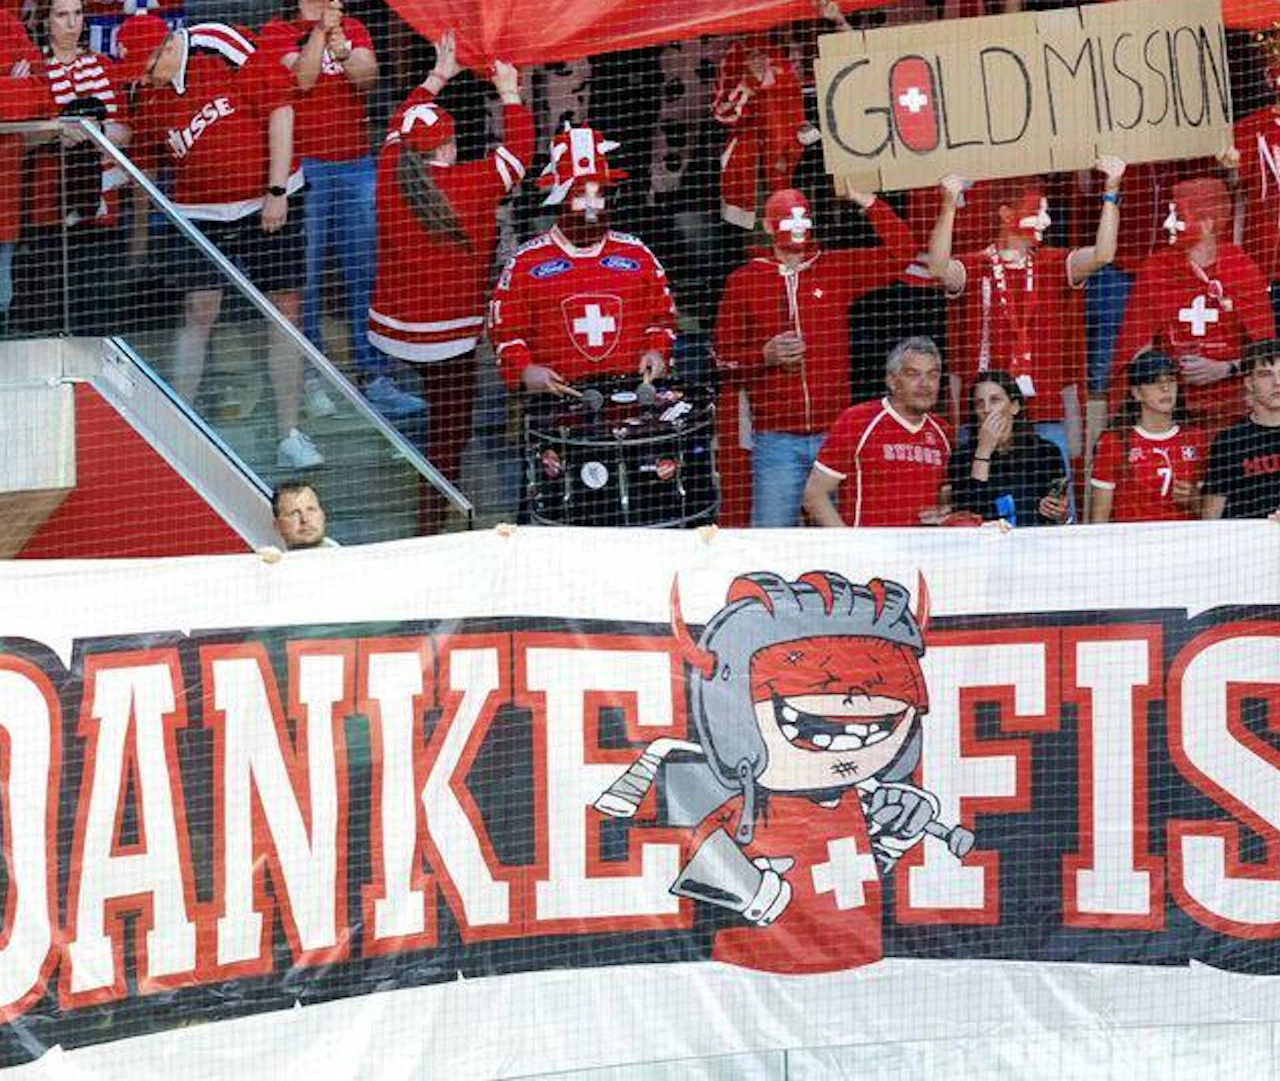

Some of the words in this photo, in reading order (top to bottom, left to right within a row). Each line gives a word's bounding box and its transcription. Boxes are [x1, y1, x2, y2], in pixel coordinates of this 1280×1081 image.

[826, 46, 1032, 158] GOLD
[1043, 24, 1231, 136] MISSION
[1157, 468, 1173, 496] 7
